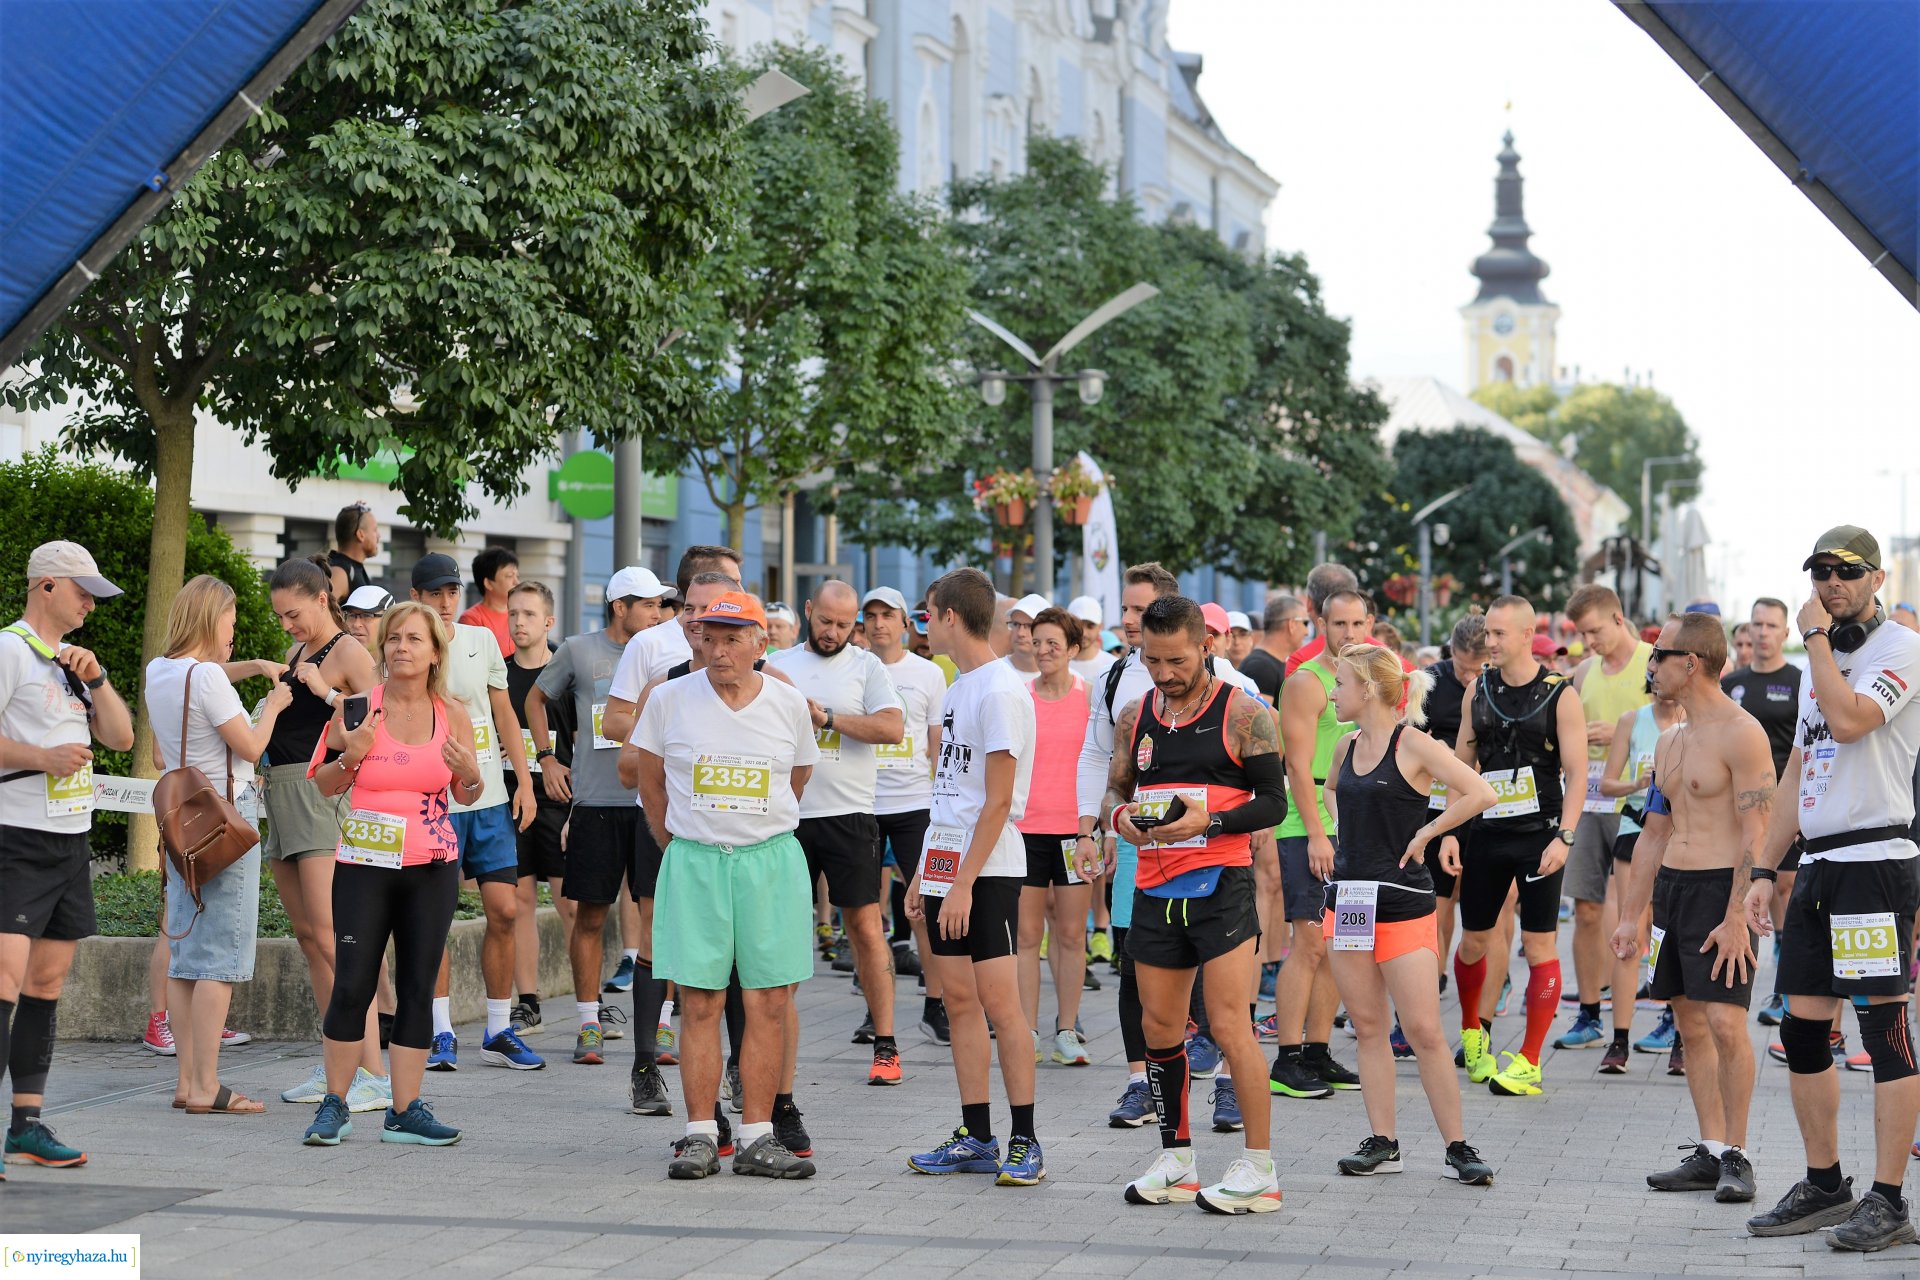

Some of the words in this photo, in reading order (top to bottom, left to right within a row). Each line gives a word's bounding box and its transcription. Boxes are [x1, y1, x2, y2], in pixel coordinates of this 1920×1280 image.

[1871, 682, 1896, 706] HUN
[700, 766, 762, 789] 2352
[1492, 779, 1529, 797] 356
[346, 820, 397, 844] 2335
[930, 857, 953, 872] 302
[1341, 912, 1367, 926] 208
[1831, 928, 1888, 950] 2103
[1148, 1060, 1168, 1127] Kalenji
